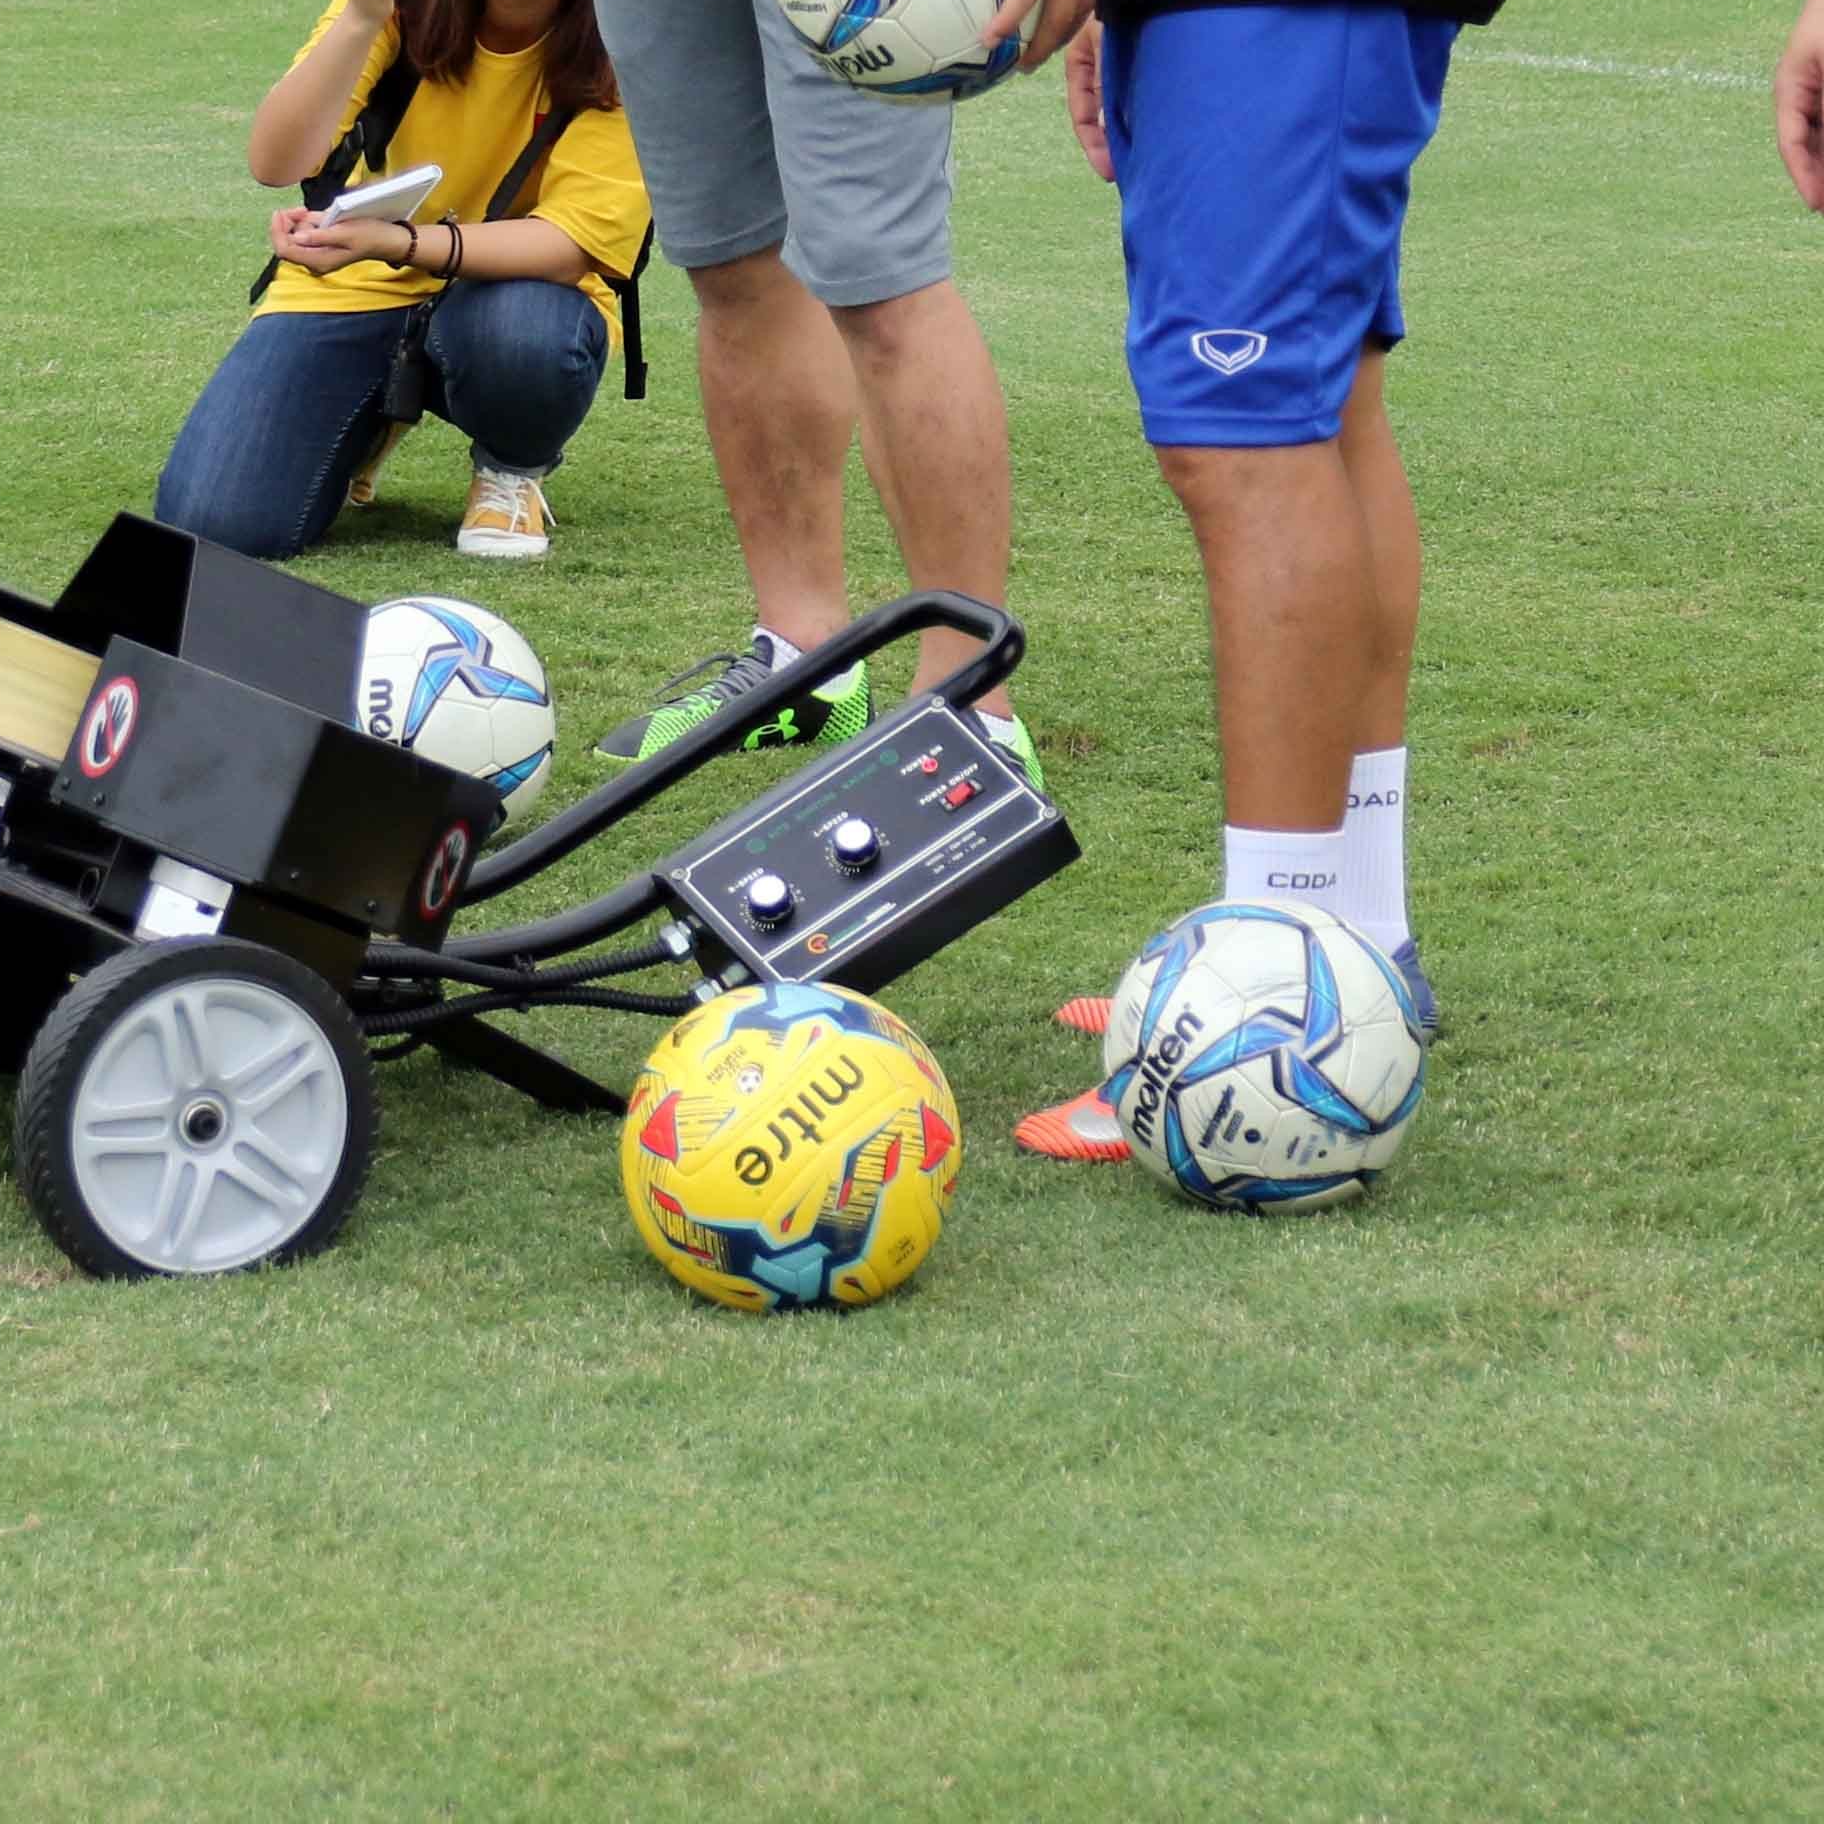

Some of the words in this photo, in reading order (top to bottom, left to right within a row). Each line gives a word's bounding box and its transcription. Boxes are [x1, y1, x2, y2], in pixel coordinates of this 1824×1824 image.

[369, 679, 398, 745] mo
[734, 1054, 865, 1187] mitre
[1131, 1010, 1205, 1149] molten
